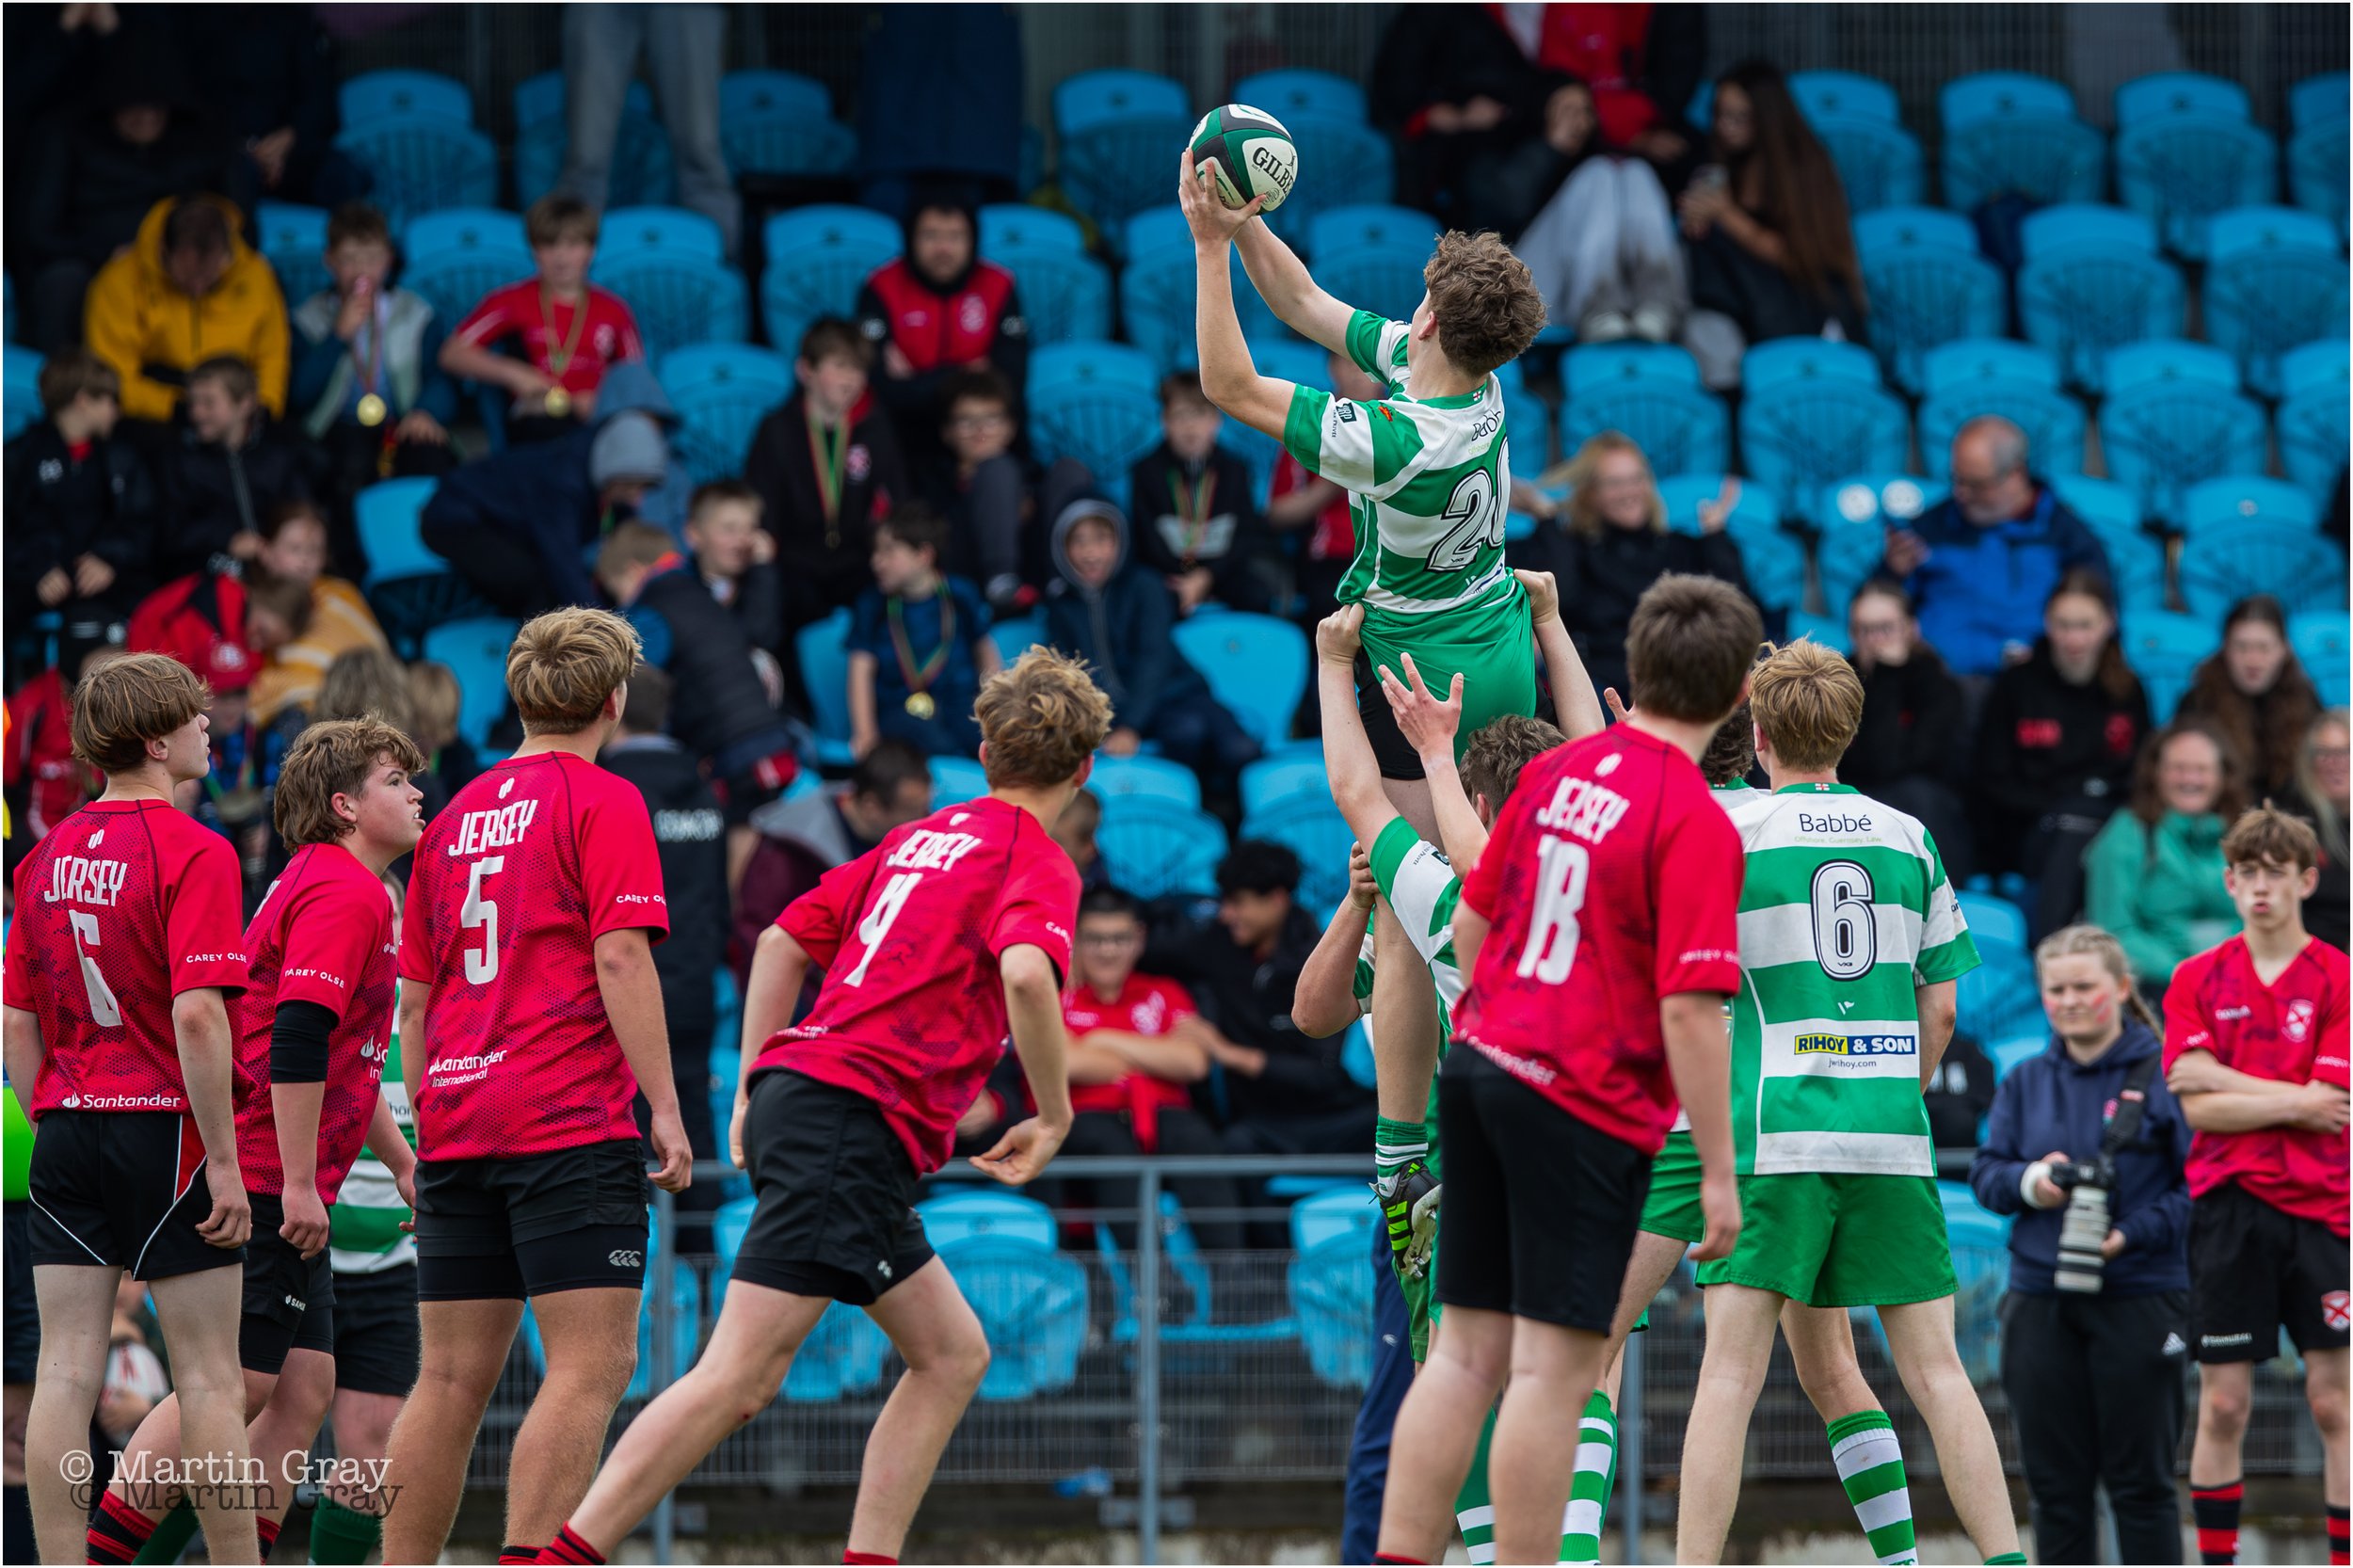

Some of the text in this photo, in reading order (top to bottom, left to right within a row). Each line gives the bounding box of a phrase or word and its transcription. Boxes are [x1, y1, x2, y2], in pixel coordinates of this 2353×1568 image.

[448, 800, 538, 856] JERSEY
[1799, 813, 1872, 833] Babbé
[44, 856, 127, 906] JERSEY
[616, 894, 667, 906] CAREY OL
[461, 855, 504, 984] 5
[843, 872, 923, 988] 4
[1516, 834, 1591, 985] 18
[1810, 858, 1878, 982] 6
[186, 953, 223, 964] CAREY
[1798, 1036, 1913, 1053] RIHOY & SON
[83, 1094, 181, 1109] Santander
